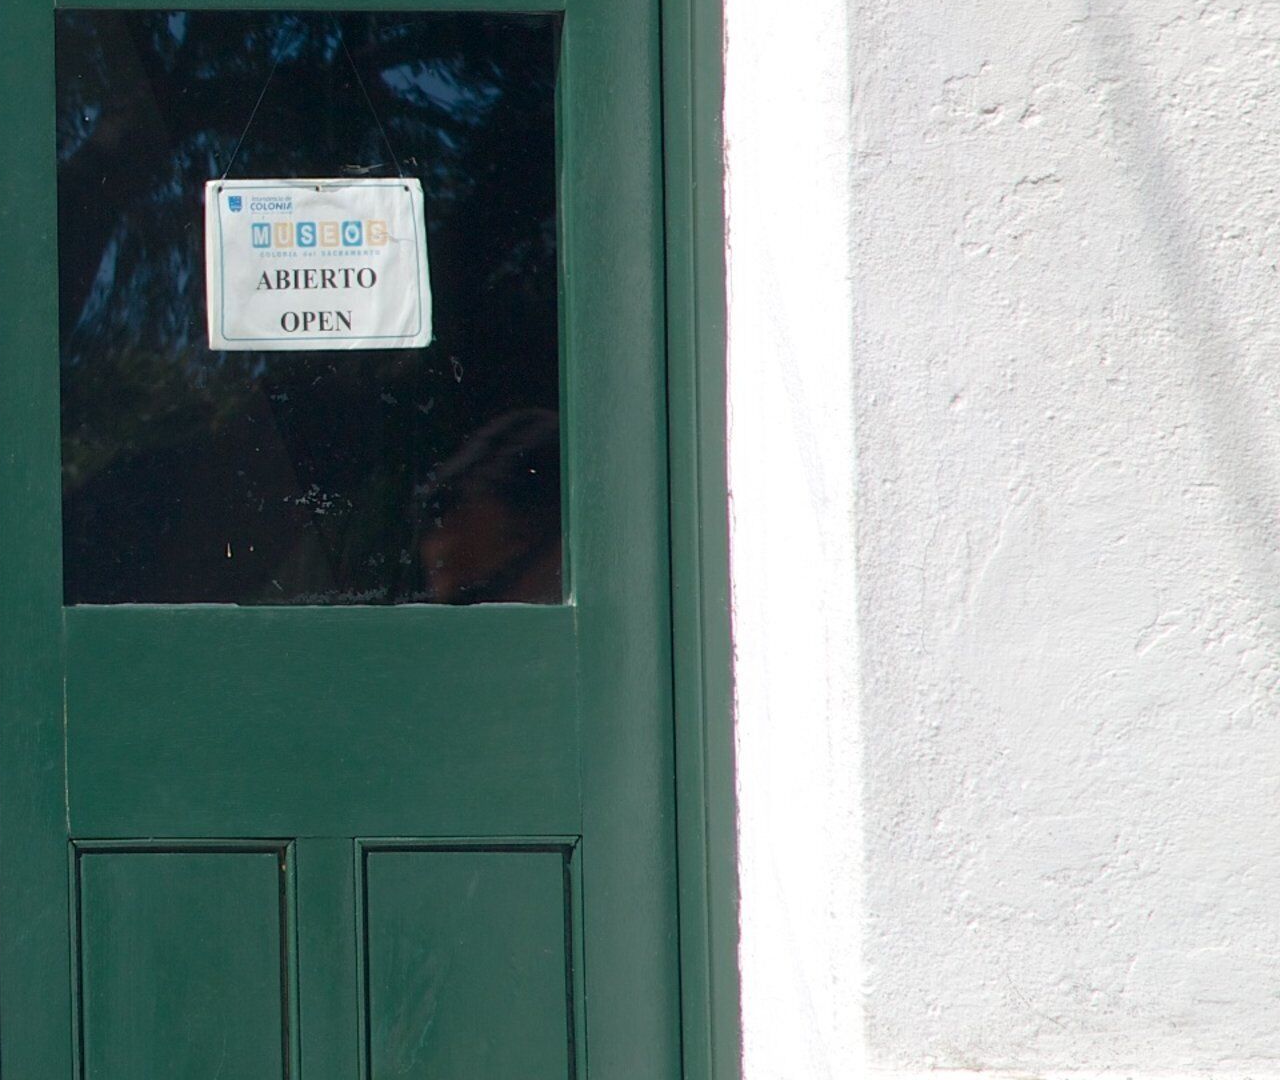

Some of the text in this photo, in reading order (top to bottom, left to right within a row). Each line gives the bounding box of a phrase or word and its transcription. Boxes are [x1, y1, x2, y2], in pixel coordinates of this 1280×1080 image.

[250, 201, 292, 211] COLONIA
[254, 223, 384, 246] MUSEOS
[256, 267, 377, 290] ABIERTO
[280, 311, 353, 332] OPEN
